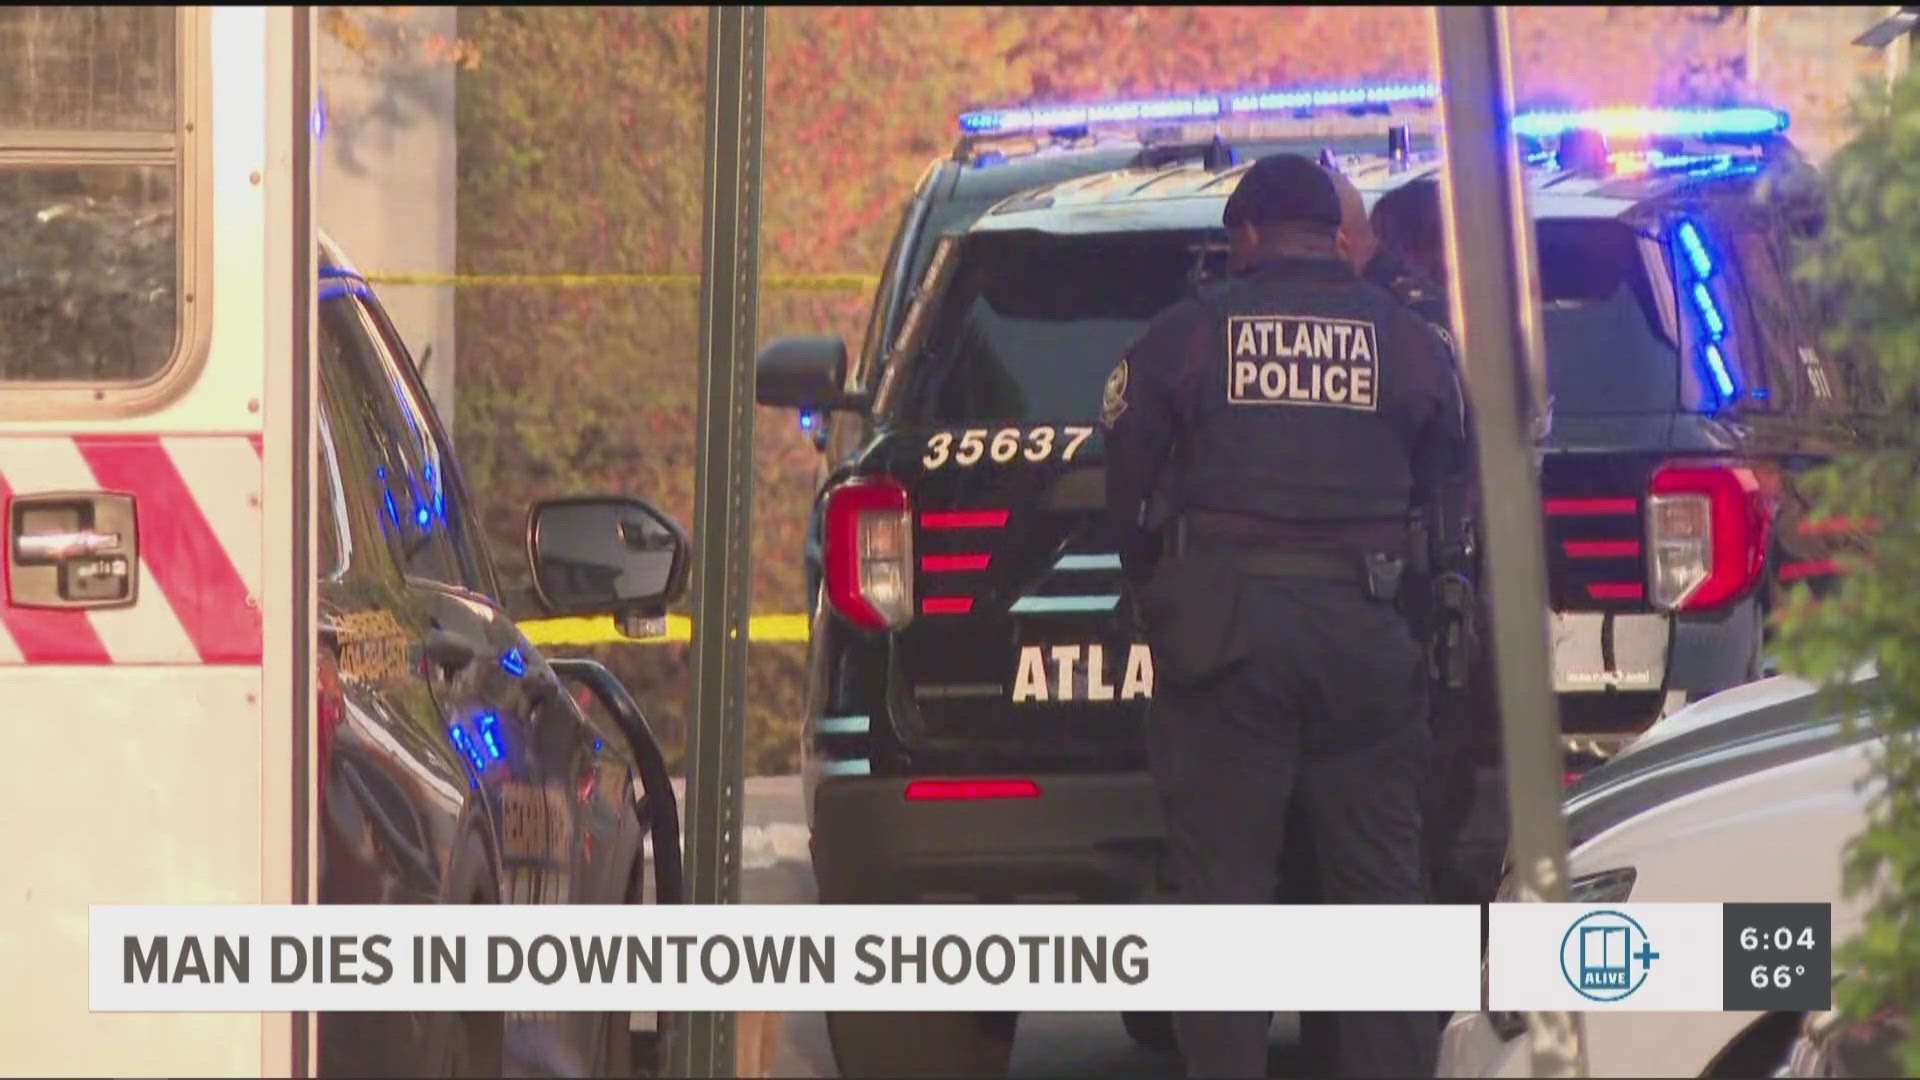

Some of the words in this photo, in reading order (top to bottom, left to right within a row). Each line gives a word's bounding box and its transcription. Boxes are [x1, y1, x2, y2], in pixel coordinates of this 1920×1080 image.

[1236, 321, 1371, 361] ATLANTA
[1235, 361, 1372, 404] POLICE
[922, 426, 1093, 470] 35637
